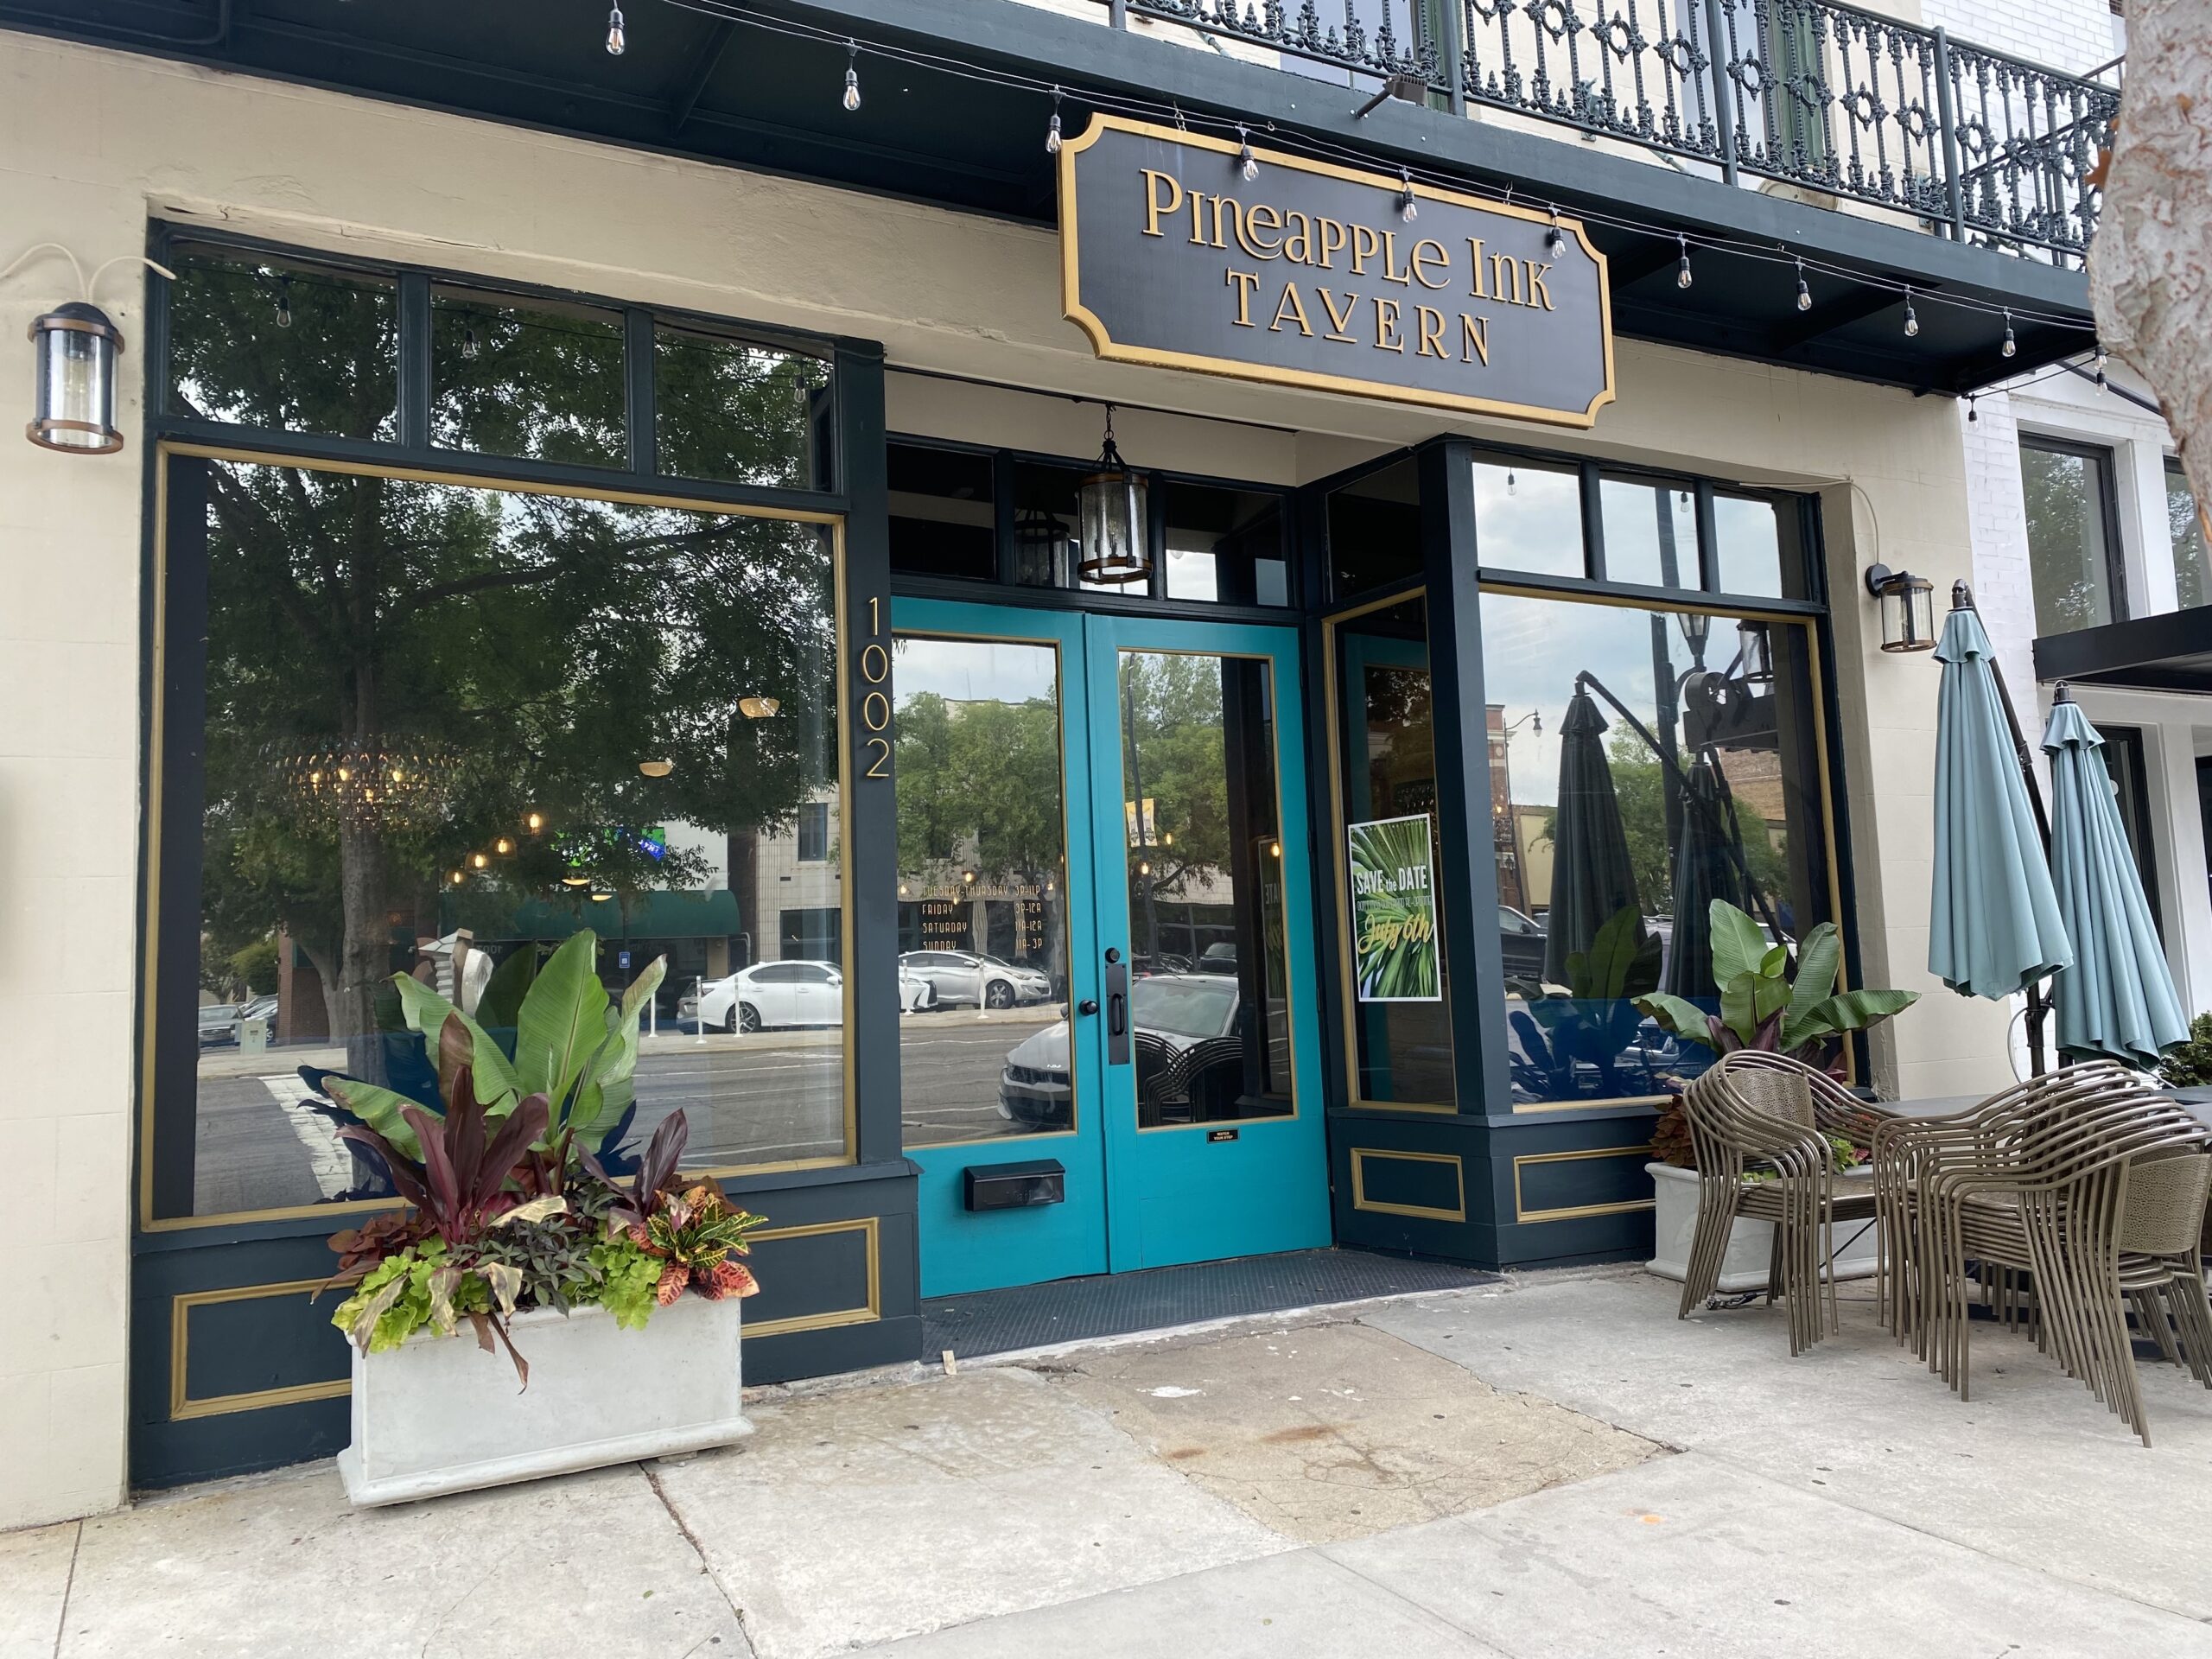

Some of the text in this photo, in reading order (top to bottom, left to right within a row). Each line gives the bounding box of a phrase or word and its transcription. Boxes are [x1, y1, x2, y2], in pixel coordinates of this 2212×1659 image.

[1226, 266, 1491, 367] TAVERN
[861, 596, 891, 778] 1002
[1357, 865, 1427, 895] SAVE the DATE
[922, 885, 1008, 897] TUESDAY-THURSDAY
[922, 903, 1041, 915] FRIDAY 3P-12A
[922, 922, 967, 933] SATURDAY
[1357, 912, 1435, 955] July 6th
[922, 940, 957, 951] SUNDAY
